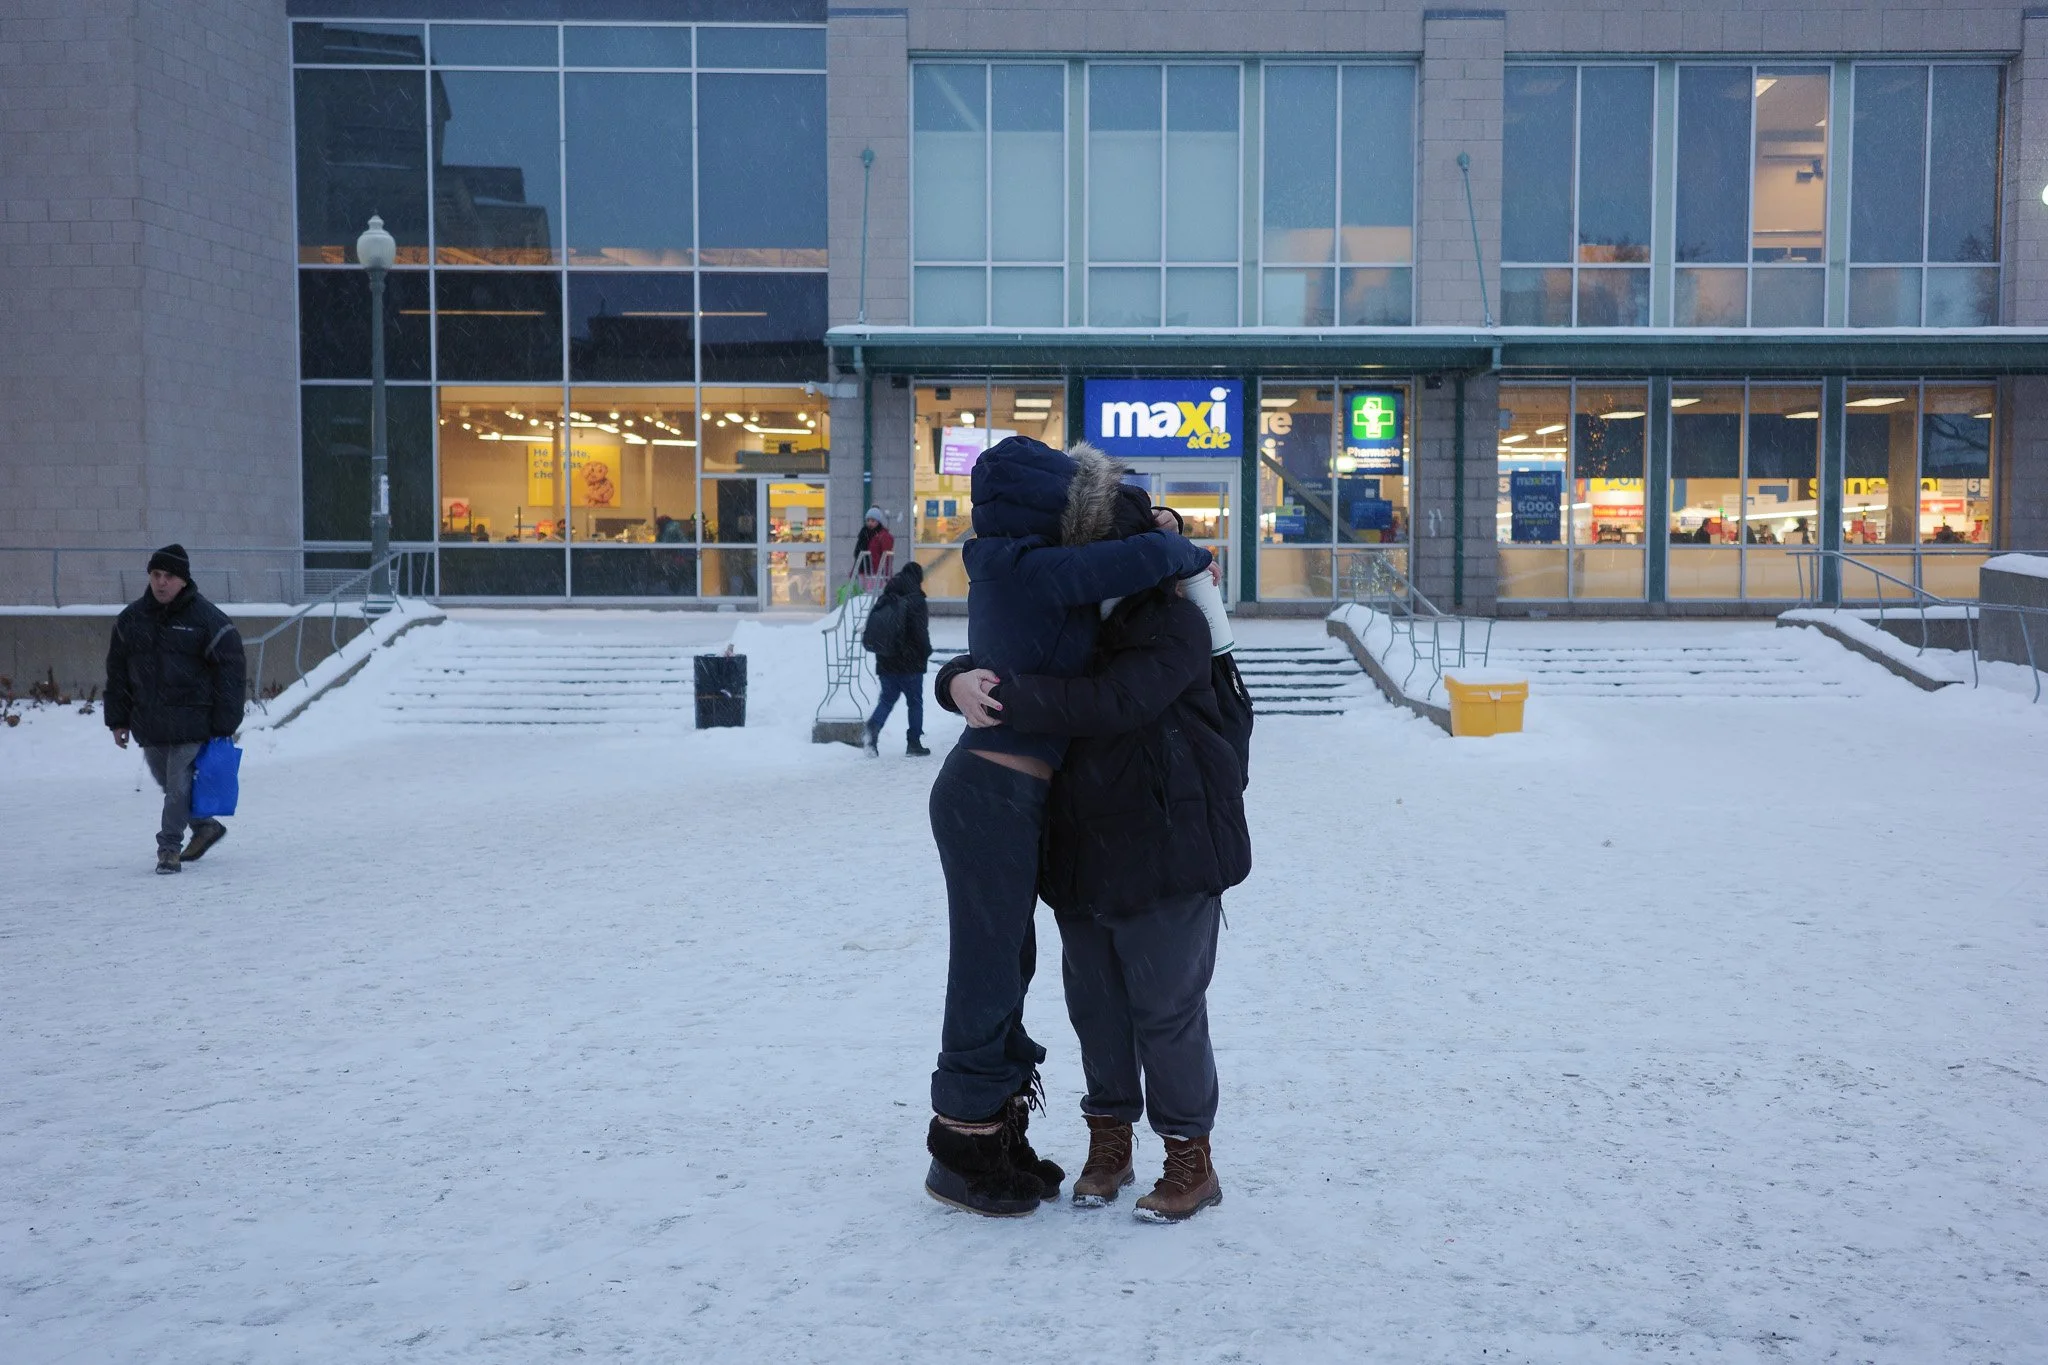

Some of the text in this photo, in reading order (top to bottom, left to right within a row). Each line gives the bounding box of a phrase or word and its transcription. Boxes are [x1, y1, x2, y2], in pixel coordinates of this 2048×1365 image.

[1101, 387, 1227, 438] maxi
[1187, 426, 1232, 449] &cie
[1518, 501, 1555, 512] 6000
